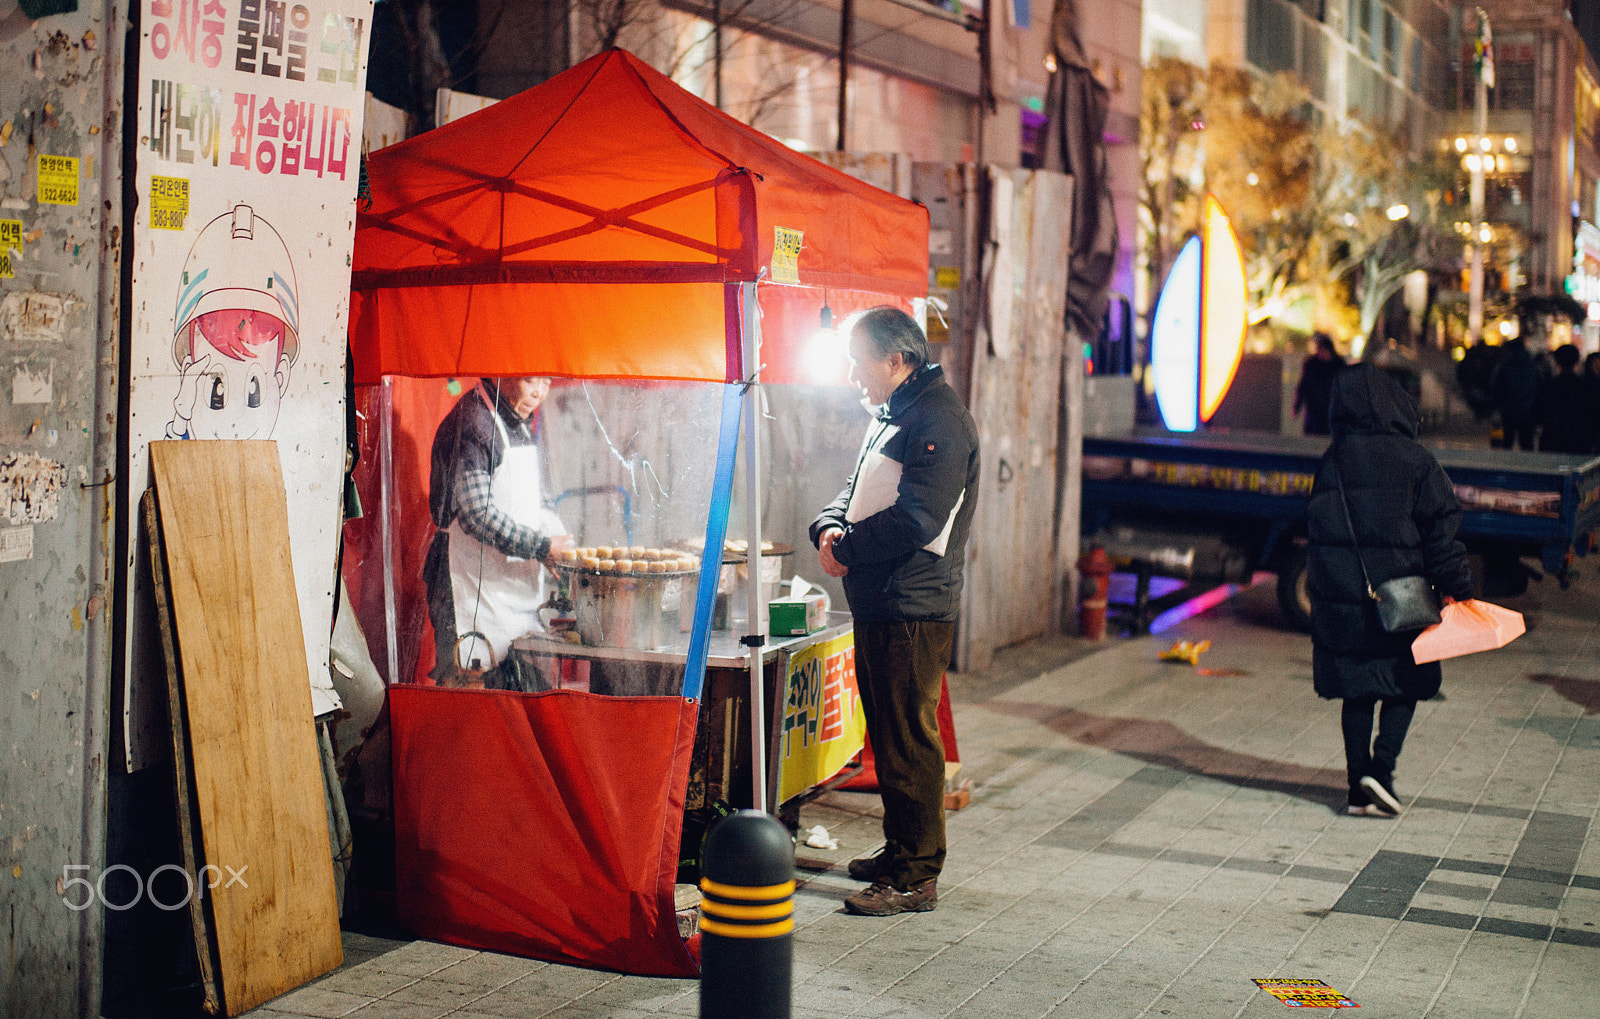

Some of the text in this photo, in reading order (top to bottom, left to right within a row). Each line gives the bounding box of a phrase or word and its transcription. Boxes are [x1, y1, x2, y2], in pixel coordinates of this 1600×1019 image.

[235, 0, 311, 82] 불편을
[230, 91, 351, 181] 죄송합니다
[784, 656, 822, 759] 추억의
